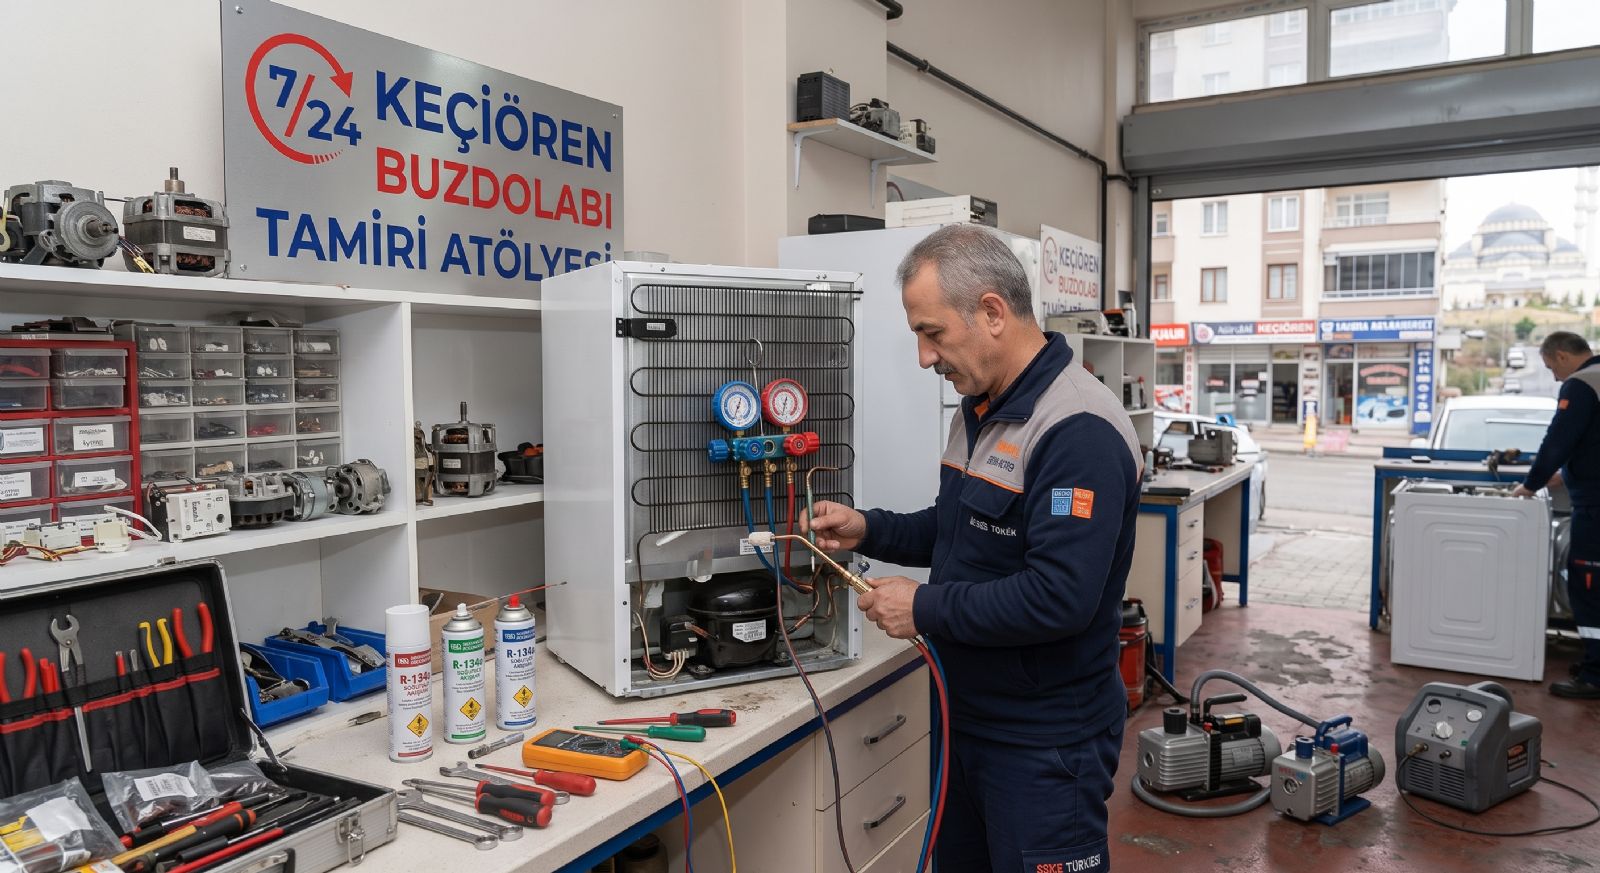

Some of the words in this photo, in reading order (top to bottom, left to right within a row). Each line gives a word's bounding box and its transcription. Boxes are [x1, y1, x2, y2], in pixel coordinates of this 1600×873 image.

[269, 65, 361, 146] 7/24
[376, 70, 611, 172] KEÇİÖREN
[377, 147, 611, 229] BUZDOLABI
[256, 207, 427, 270] TAMİRİ
[1060, 245, 1099, 274] KEÇİÖREN
[1059, 275, 1098, 298] BUZDOLABI
[400, 671, 430, 685] R-134a
[452, 657, 483, 669] R-134a
